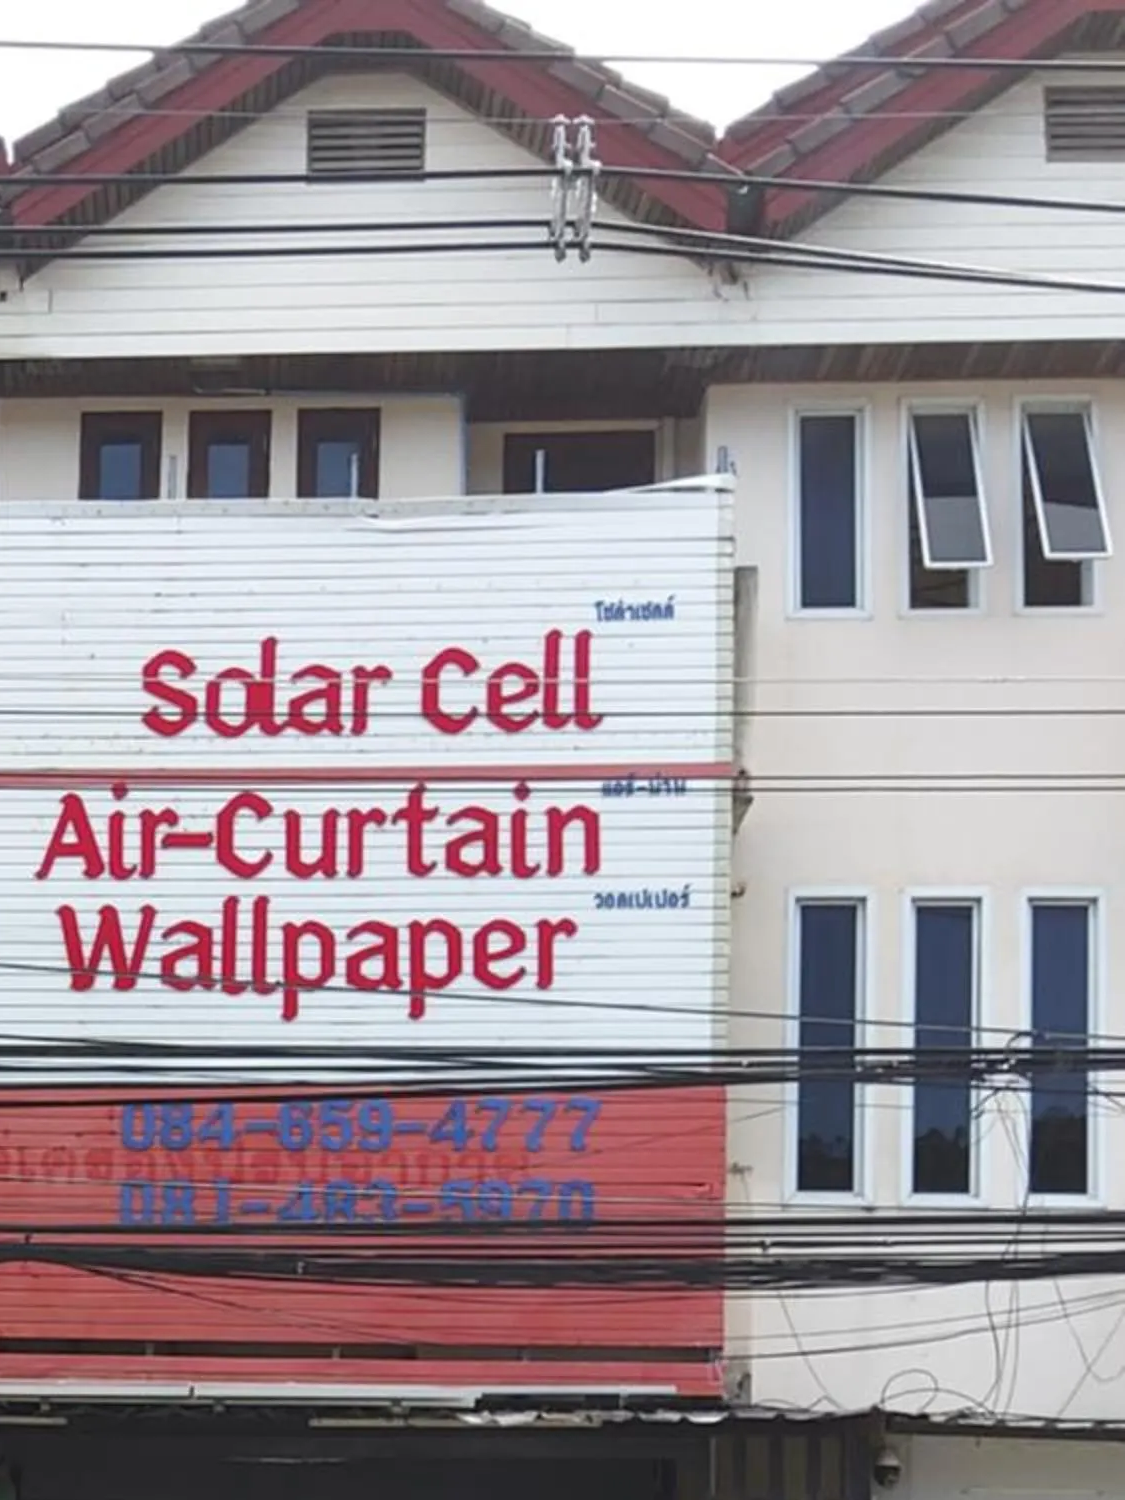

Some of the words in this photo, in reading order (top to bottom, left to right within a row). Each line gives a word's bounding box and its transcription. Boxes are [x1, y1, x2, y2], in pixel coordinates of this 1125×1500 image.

[141, 636, 392, 738] Solar
[420, 628, 604, 734] Cell
[35, 781, 601, 880] Air-Curtain
[56, 895, 578, 1022] Wallpaper
[119, 1096, 603, 1154] 084-659-4777
